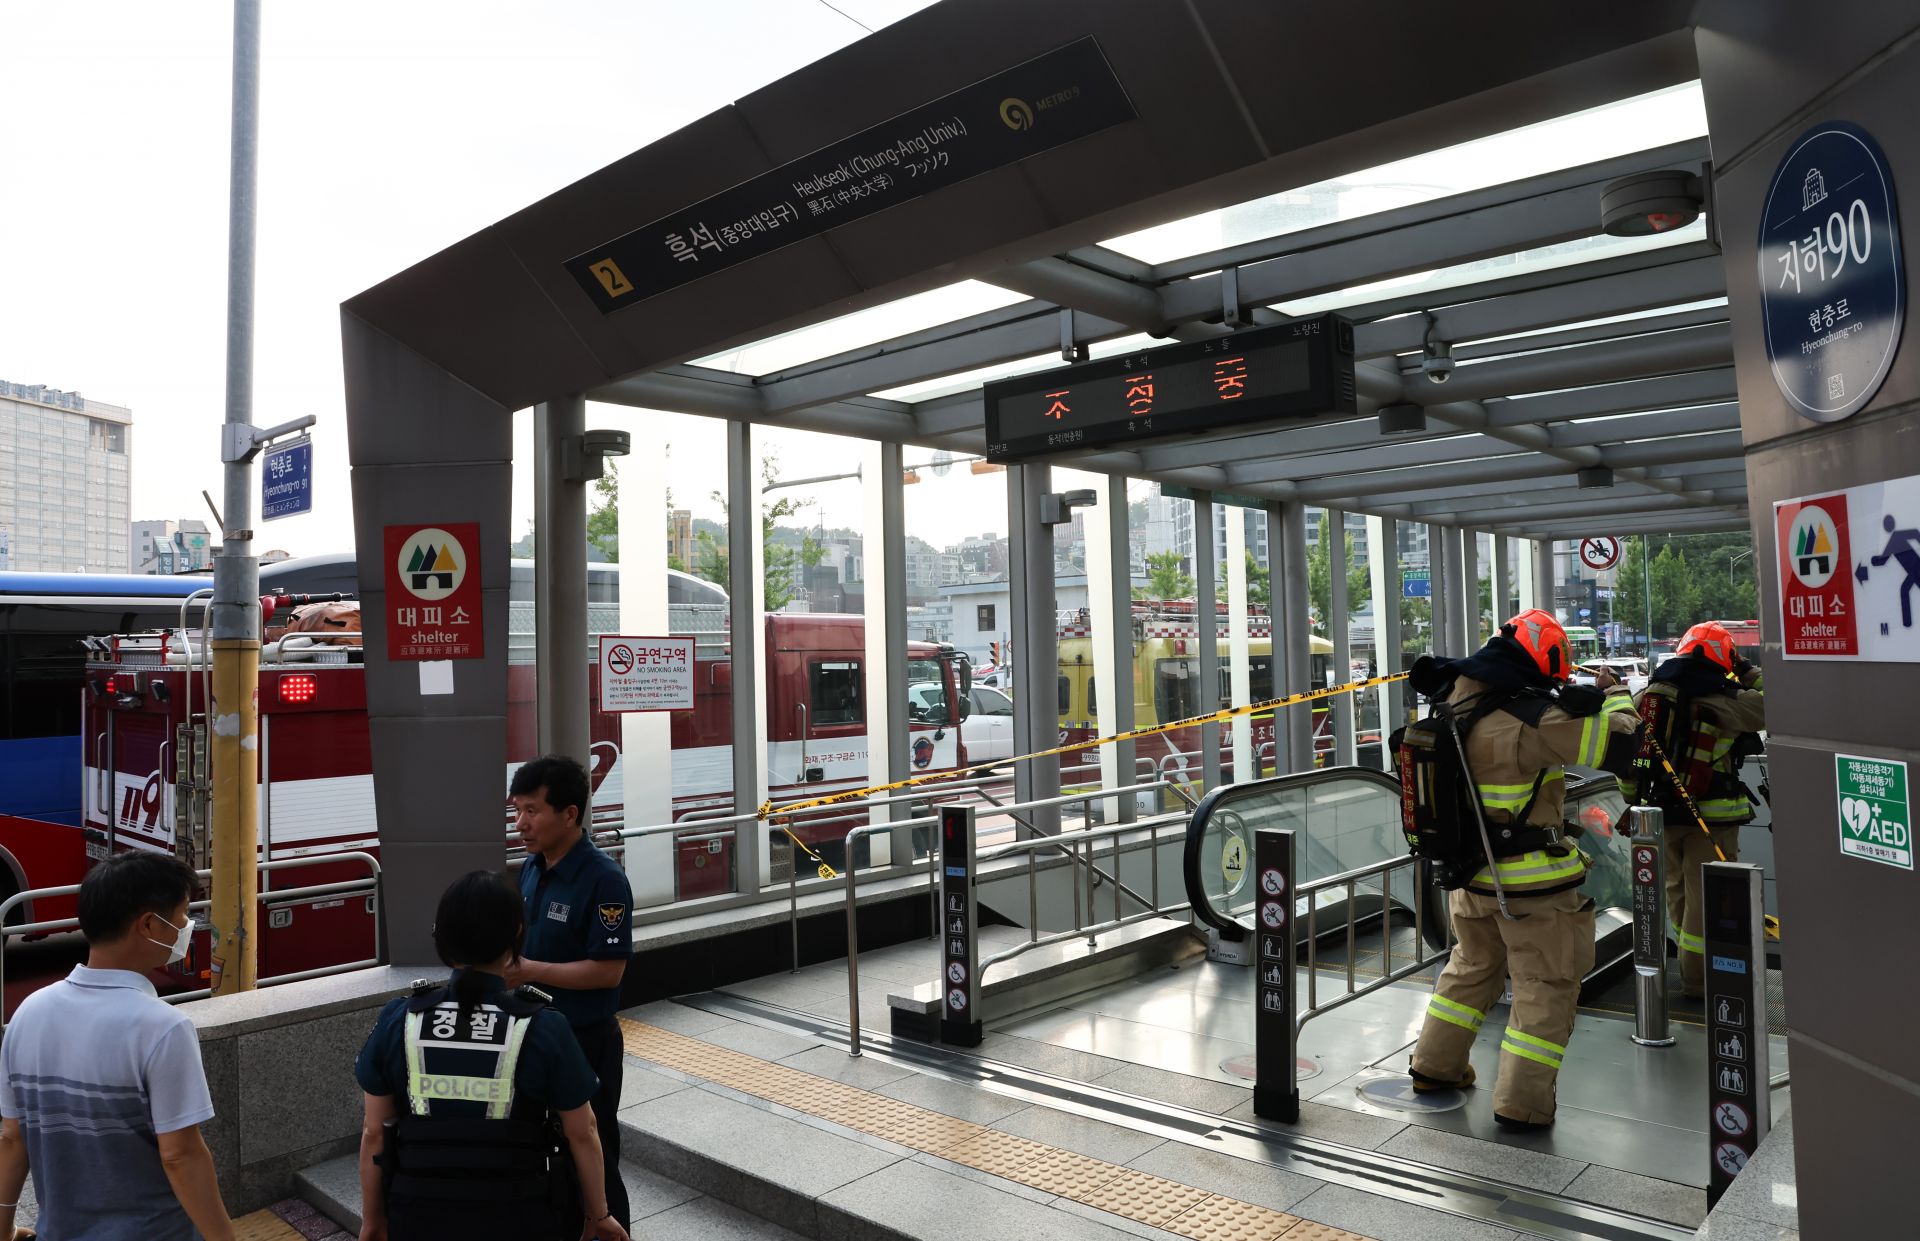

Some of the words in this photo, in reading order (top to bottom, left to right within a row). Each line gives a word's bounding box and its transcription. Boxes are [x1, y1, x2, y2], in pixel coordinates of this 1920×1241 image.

[792, 163, 854, 198] Heukseok
[923, 116, 968, 145] Univ.)
[904, 151, 949, 178] フッソク
[1777, 198, 1873, 294] 지하90
[599, 265, 625, 290] 2
[1808, 298, 1851, 333] 현충로
[1292, 322, 1321, 337] 노량진
[1801, 321, 1863, 354] Hyeonchung-ro
[988, 443, 1009, 455] 구반포
[270, 455, 294, 479] 현충로
[263, 480, 300, 499] Hyeonchung-ro
[397, 605, 470, 627] 대피소
[1789, 594, 1846, 618] 대피소
[411, 630, 459, 645] shelter
[1801, 622, 1838, 637] shelter
[1880, 622, 1889, 636] M
[636, 647, 686, 665] 금연구역
[1848, 761, 1894, 776] 자동심장충격기
[1849, 772, 1894, 788] (자동제세동기)
[1859, 783, 1886, 797] 설치시설
[120, 773, 162, 833] 119
[1868, 818, 1907, 847] AED
[1635, 884, 1644, 912] 휠체어
[1648, 886, 1656, 913] 유모차
[1641, 914, 1651, 955] 진입금지
[432, 1010, 498, 1041] 경찰
[420, 1077, 501, 1100] POLICE
